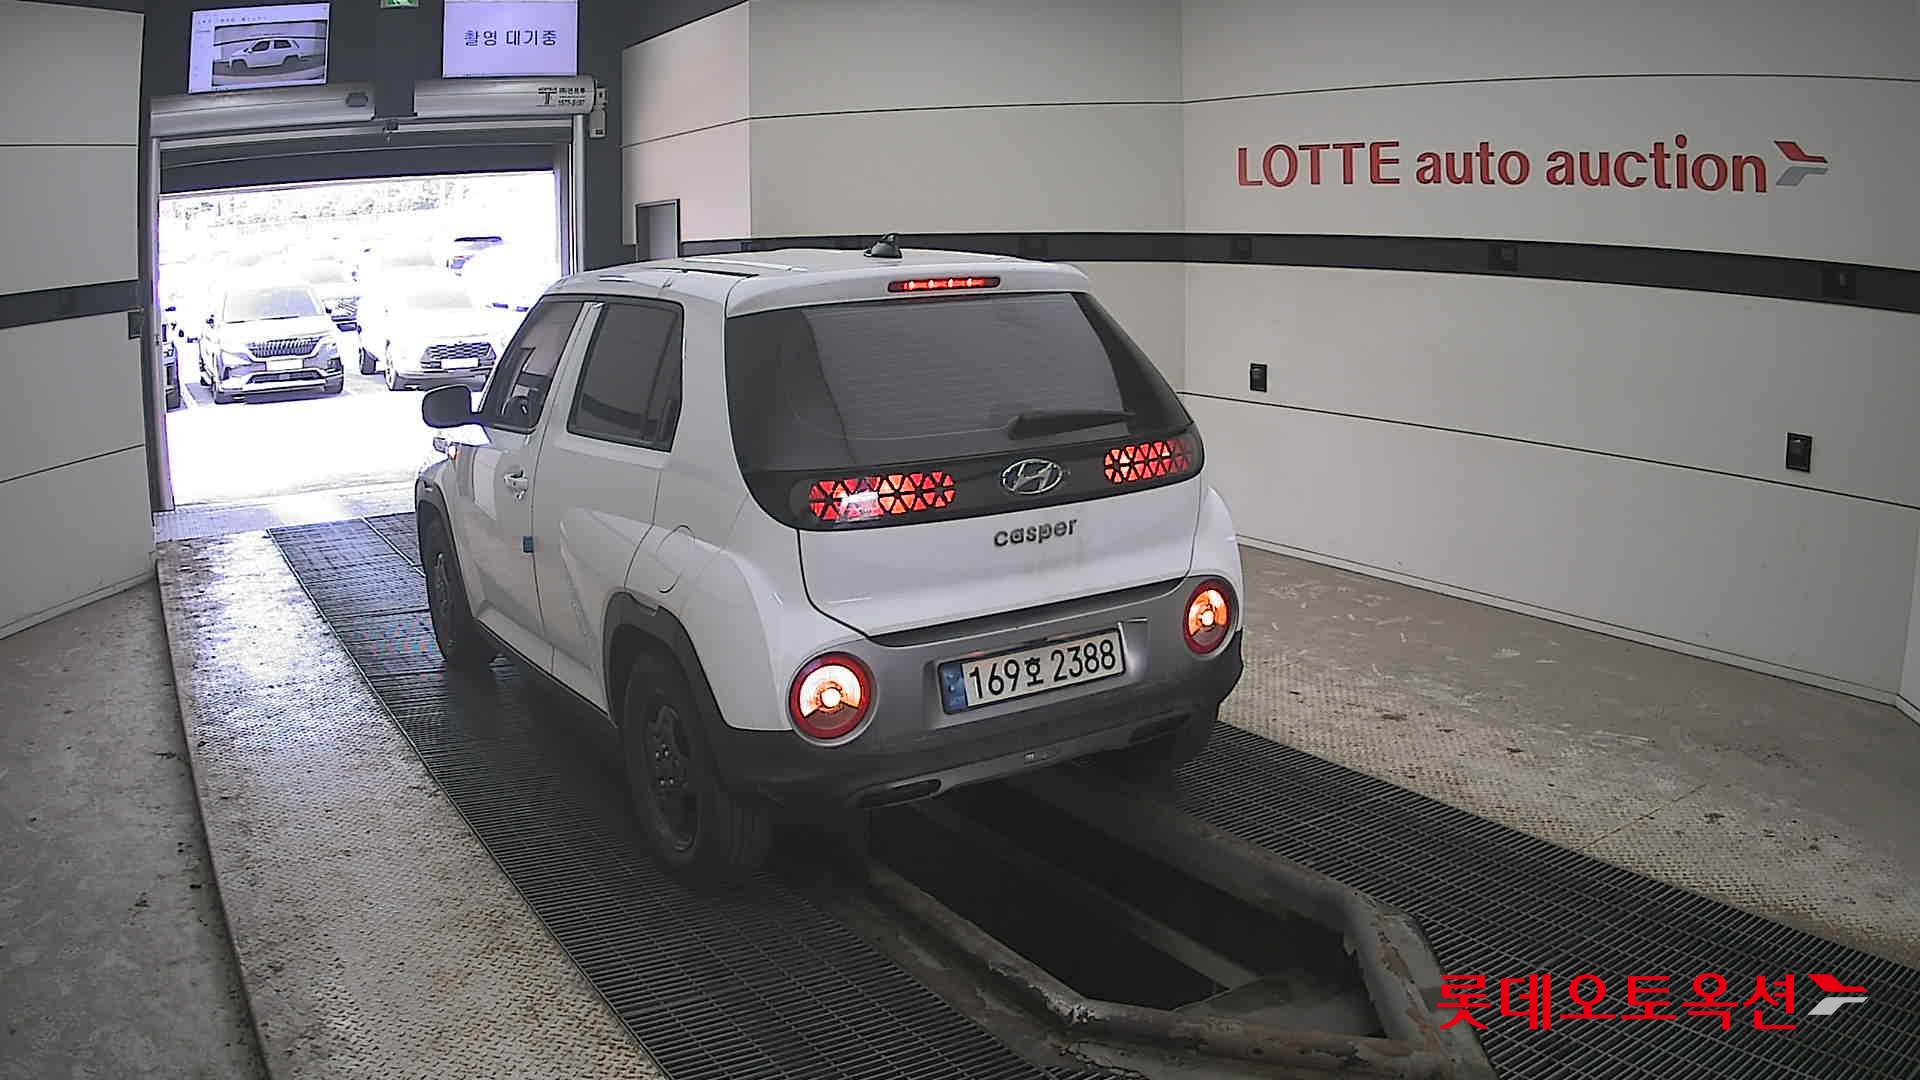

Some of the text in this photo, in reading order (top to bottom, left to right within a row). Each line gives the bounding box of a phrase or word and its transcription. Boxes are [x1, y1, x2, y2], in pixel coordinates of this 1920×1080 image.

[464, 30, 557, 46] 촬영 대기중
[1236, 135, 1767, 192] LOTTE auto auction
[993, 519, 1077, 547] casper
[968, 639, 1116, 699] 169호 2388
